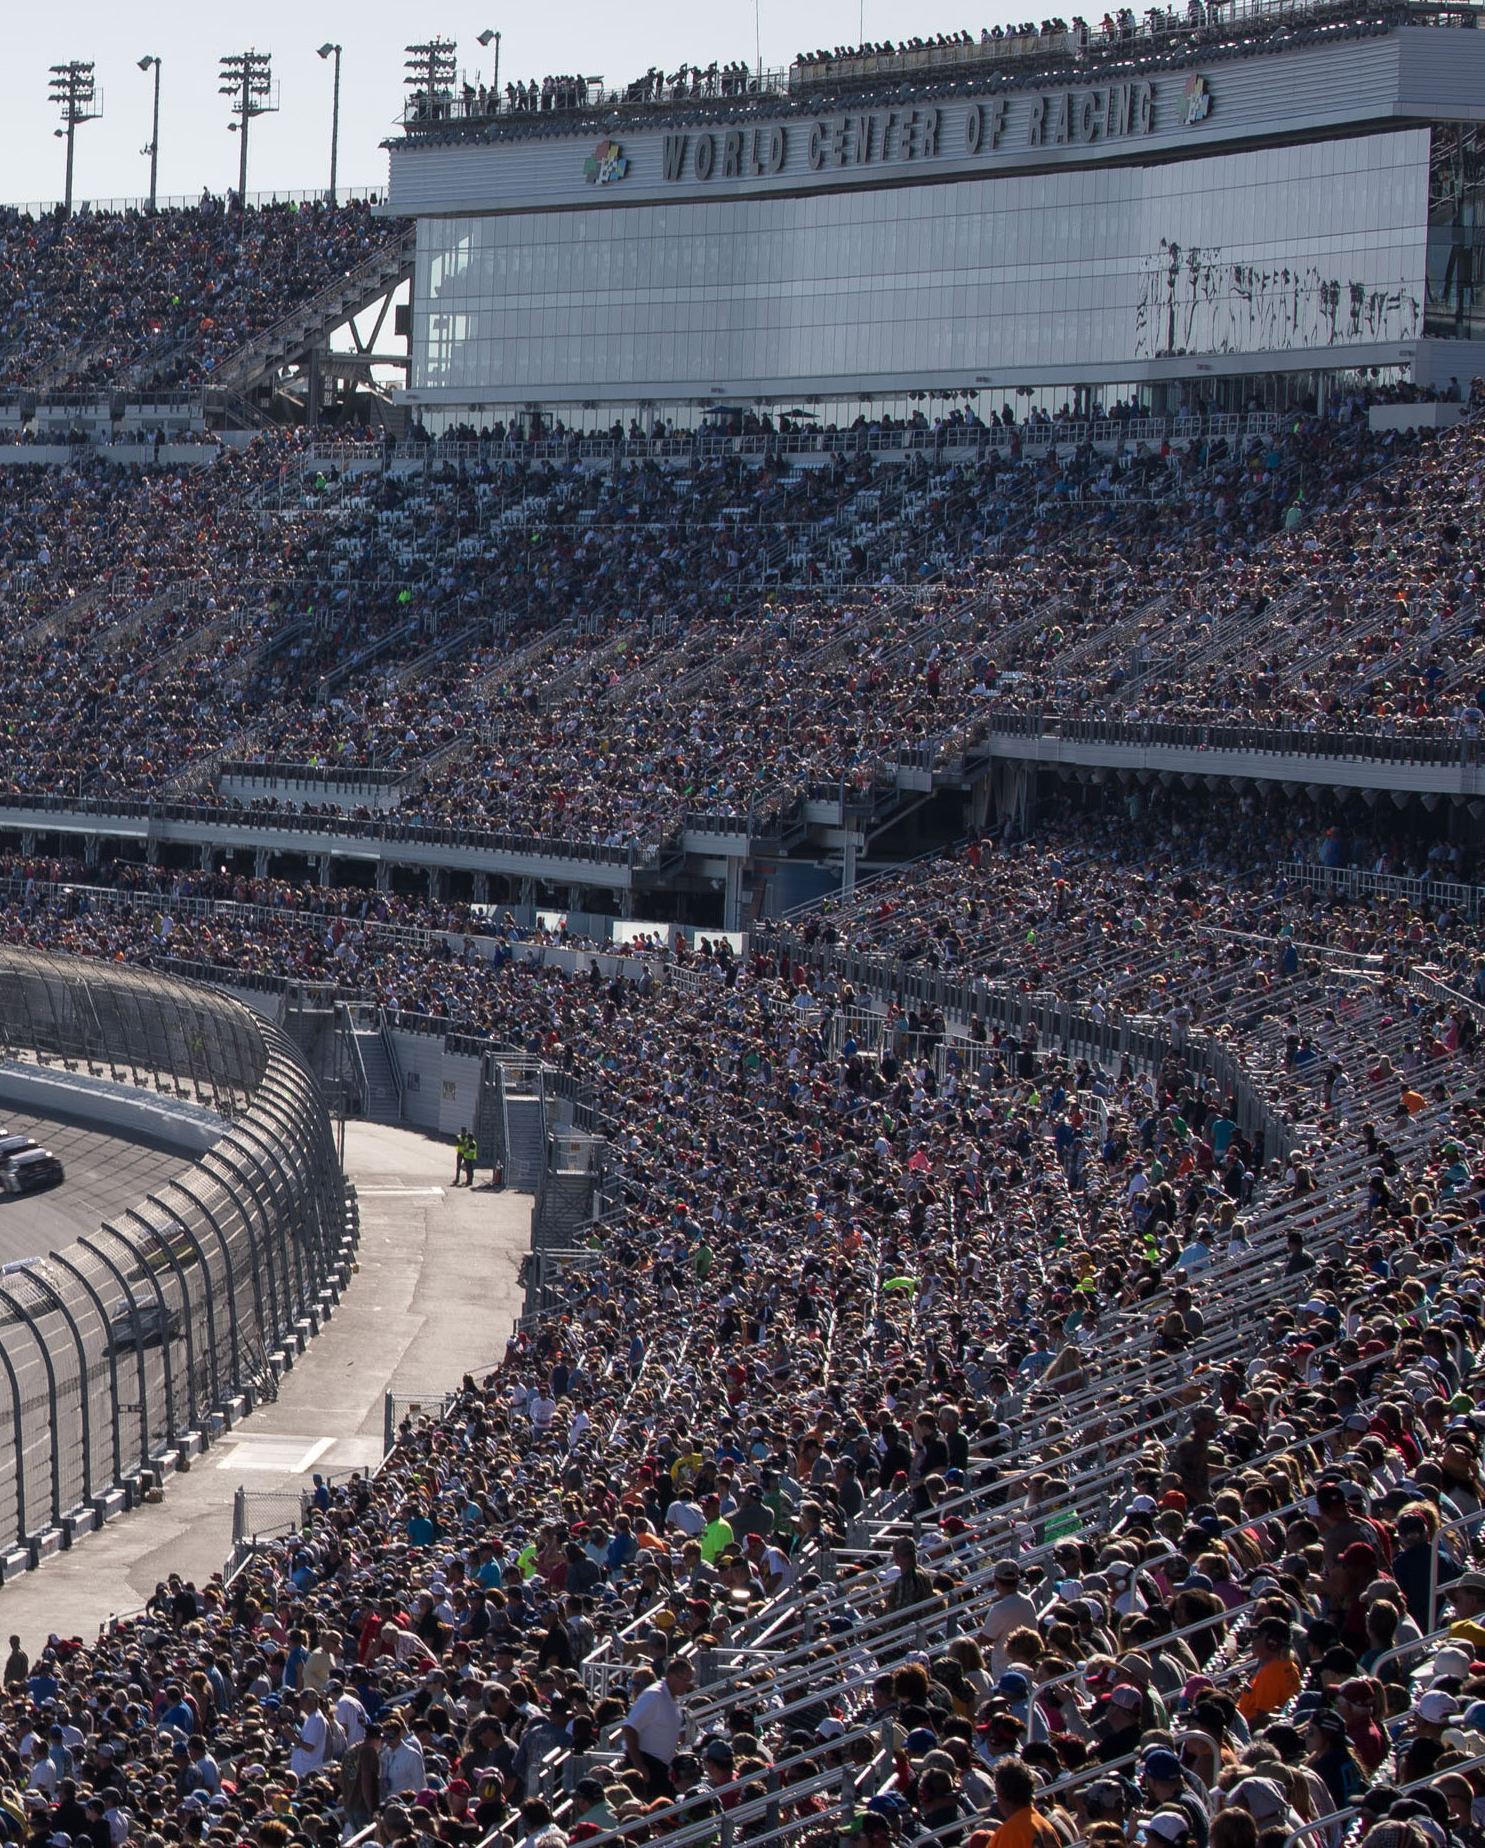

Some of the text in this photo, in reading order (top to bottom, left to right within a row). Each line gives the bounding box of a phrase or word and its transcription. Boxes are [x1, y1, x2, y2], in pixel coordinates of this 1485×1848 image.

[662, 81, 1154, 181] WORLD CENTER OF RACING
